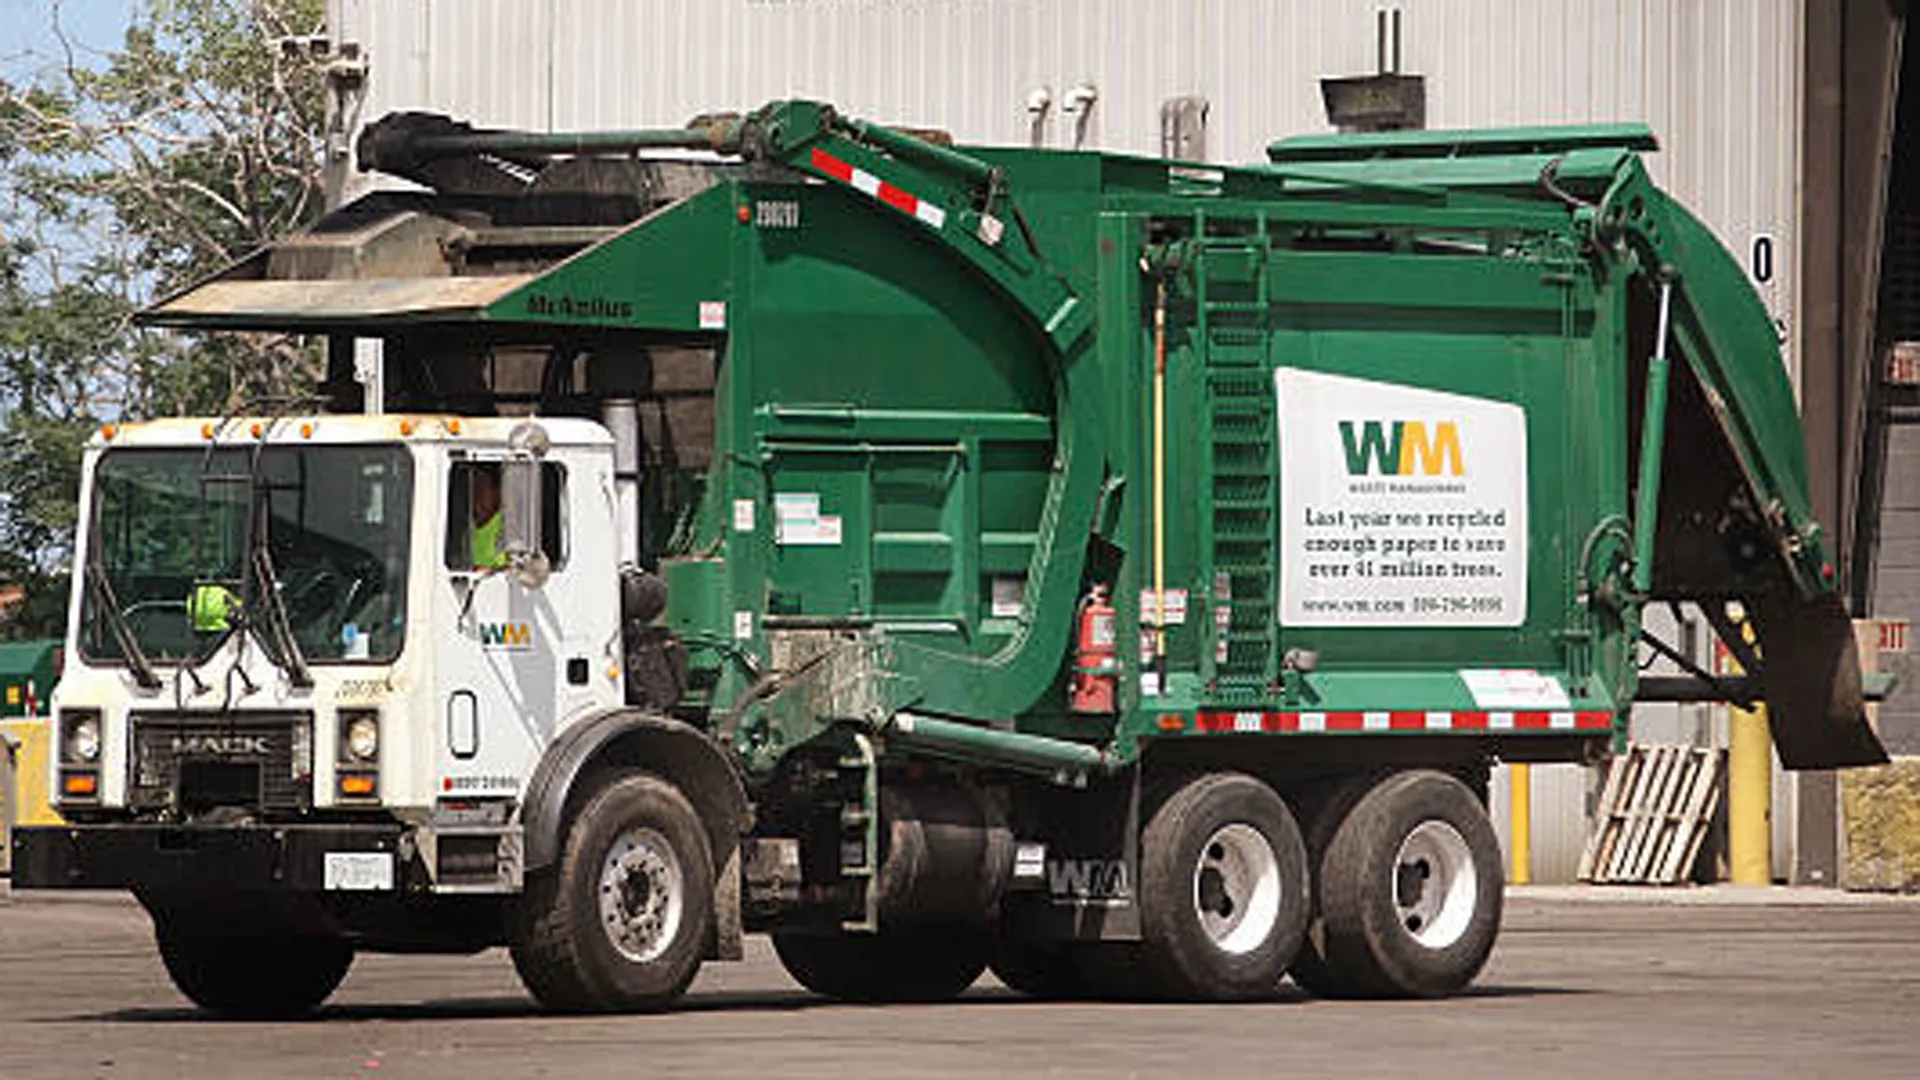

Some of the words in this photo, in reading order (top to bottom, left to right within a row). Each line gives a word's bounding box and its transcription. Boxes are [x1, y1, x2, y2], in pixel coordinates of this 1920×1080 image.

[1338, 421, 1464, 476] WM
[1305, 508, 1344, 526] Last
[1427, 509, 1506, 530] recycled
[1380, 561, 1448, 577] million
[479, 622, 532, 645] WM
[1047, 860, 1129, 895] WM
